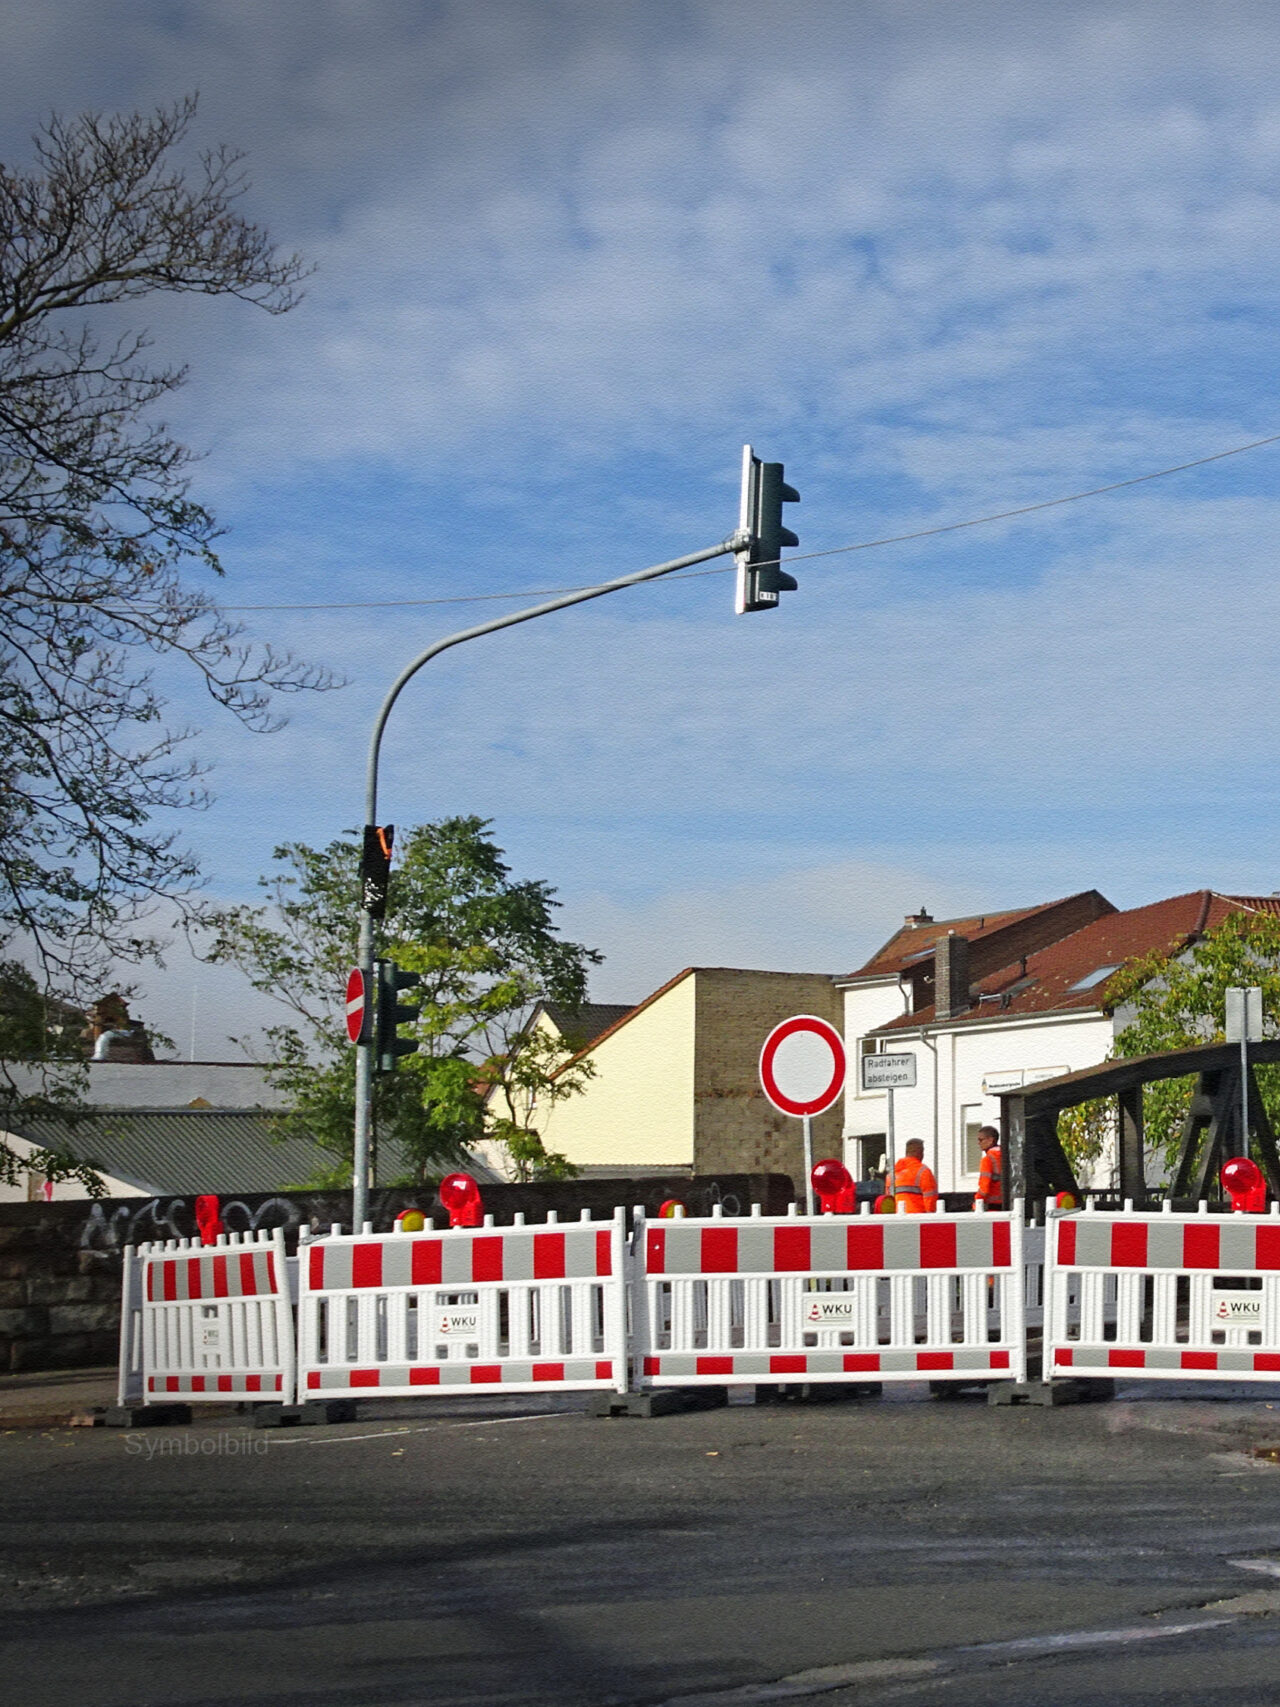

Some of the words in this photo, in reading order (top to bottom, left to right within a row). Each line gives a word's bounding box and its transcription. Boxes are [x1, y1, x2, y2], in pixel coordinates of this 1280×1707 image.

[868, 1058, 909, 1068] Radfahrer
[867, 1073, 908, 1084] absteigen
[822, 1304, 852, 1314] WKU
[1230, 1302, 1260, 1313] WKU
[451, 1316, 476, 1326] WKU
